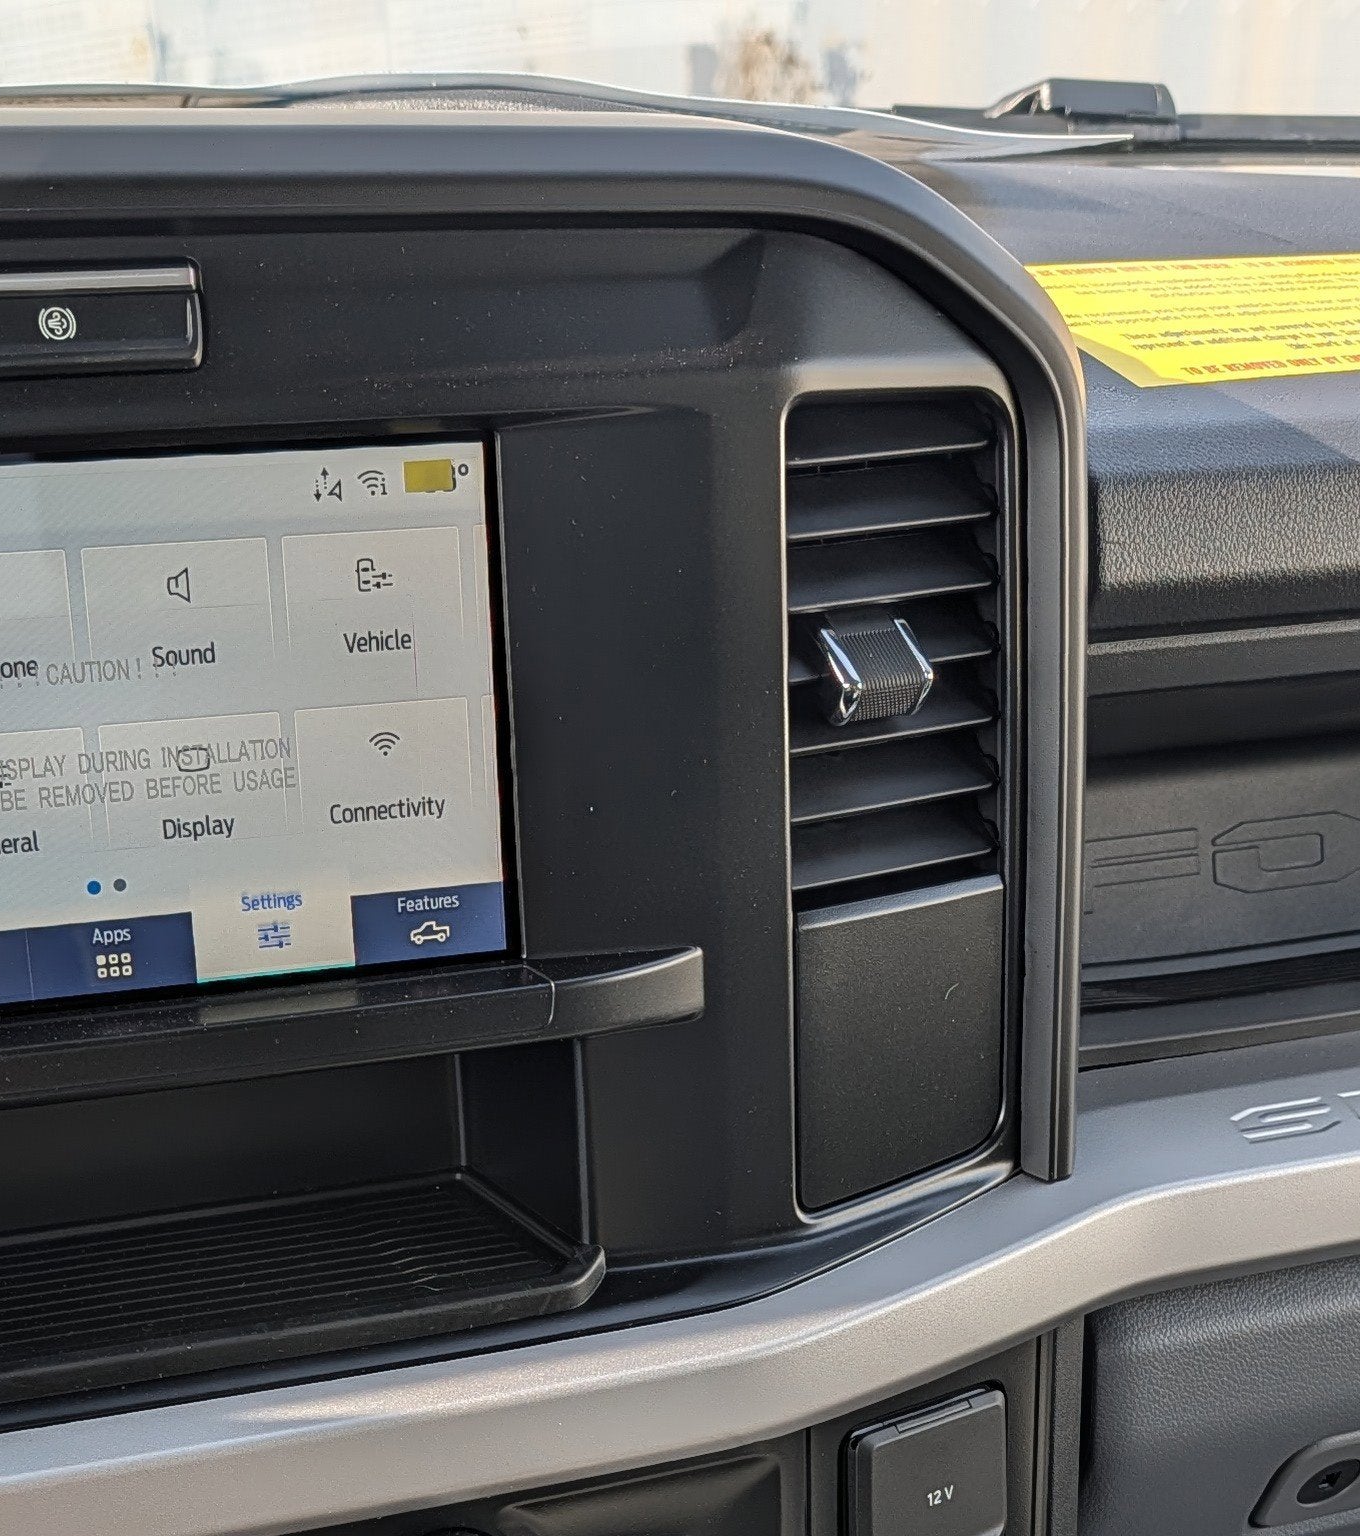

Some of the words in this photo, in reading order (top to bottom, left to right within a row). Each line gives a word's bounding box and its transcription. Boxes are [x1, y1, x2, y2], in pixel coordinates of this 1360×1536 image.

[343, 629, 412, 654] Vehicle
[152, 643, 216, 669] Sound
[46, 658, 130, 686] CAUTION
[78, 749, 151, 775] DURING
[161, 738, 291, 768] INSTALLATION
[1, 788, 27, 812] BE
[39, 781, 135, 809] REMOVED
[146, 774, 222, 800] BEFORE
[233, 766, 296, 793] USAGE
[330, 796, 445, 824] Connectivity
[162, 815, 235, 841] Display
[241, 890, 303, 912] Settings
[396, 890, 460, 912] Features
[92, 926, 132, 948] Apps
[927, 1489, 942, 1506] 12
[943, 1485, 954, 1500] V
